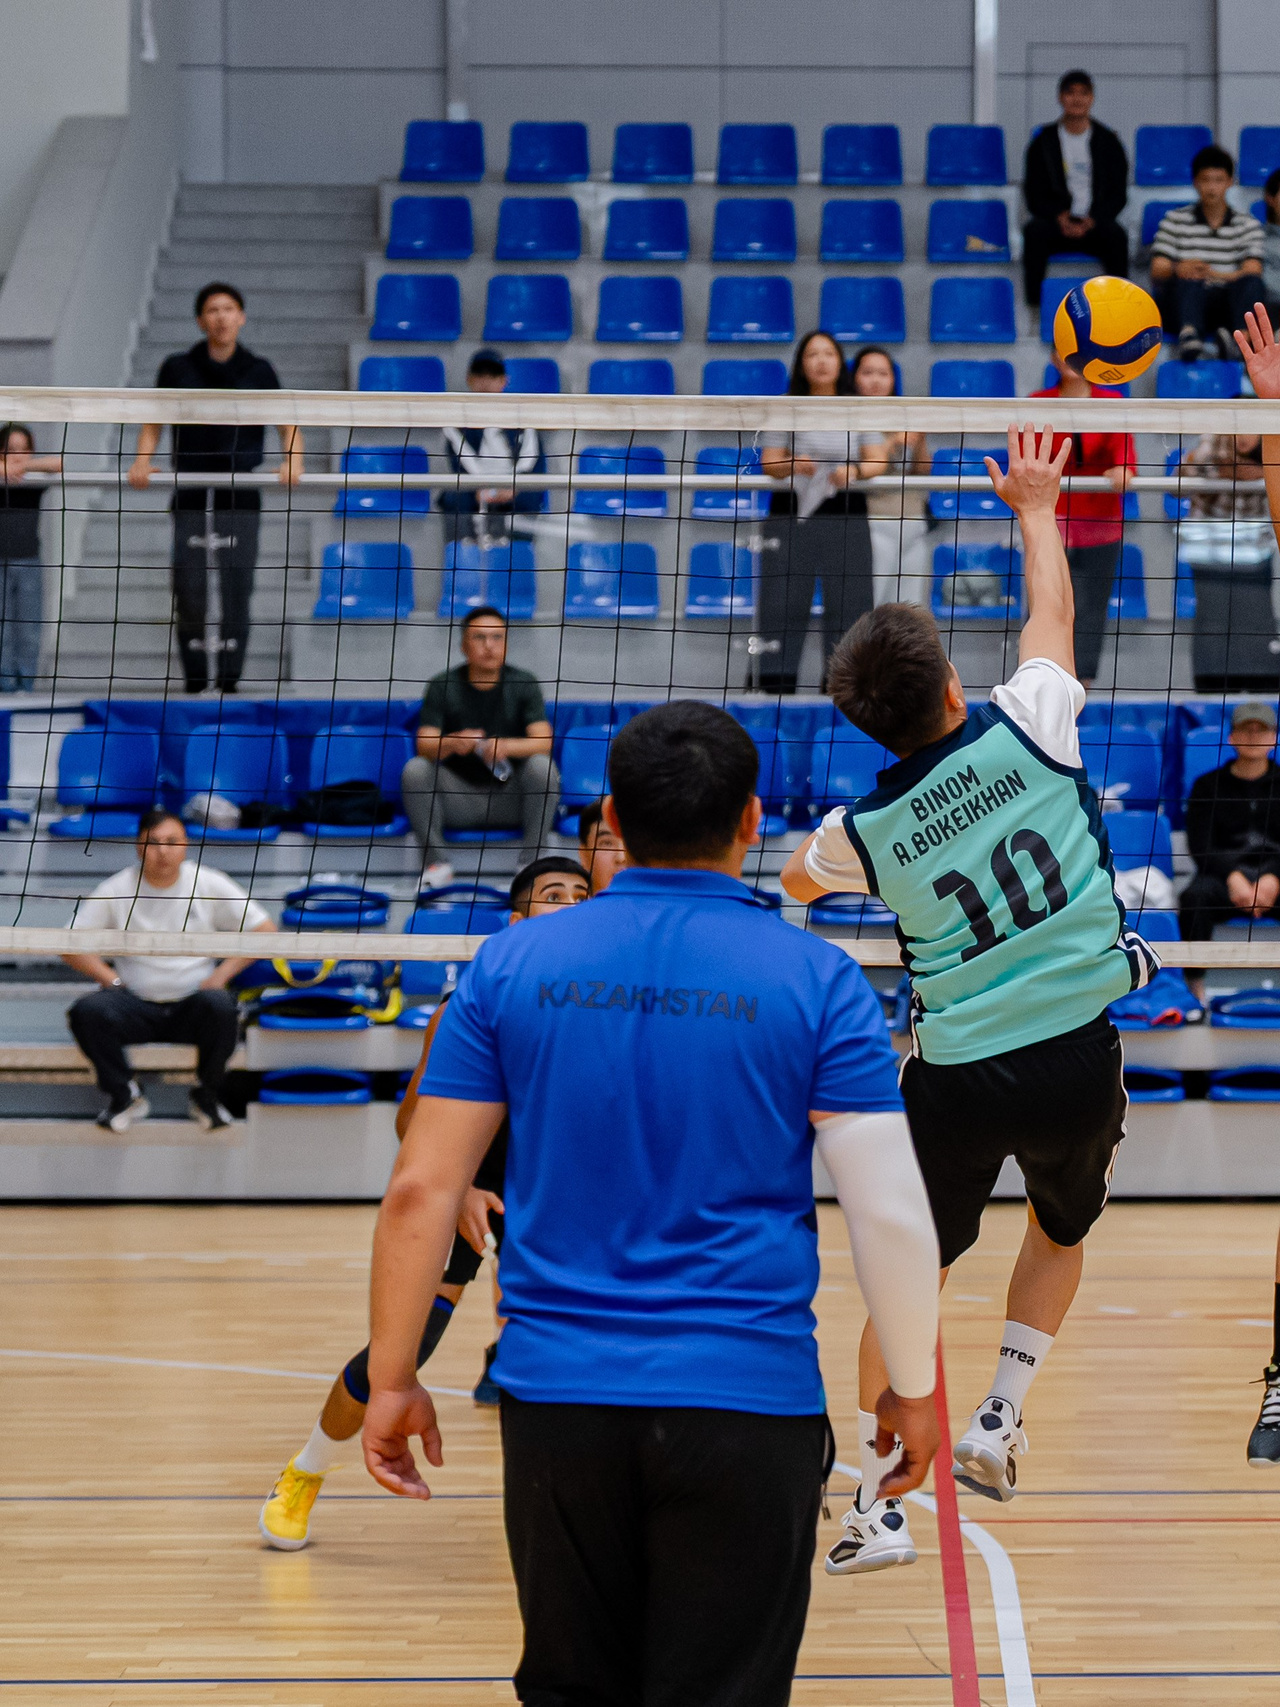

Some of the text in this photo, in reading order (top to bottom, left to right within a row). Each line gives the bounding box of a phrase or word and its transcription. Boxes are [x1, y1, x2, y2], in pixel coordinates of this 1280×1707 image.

[892, 769, 1028, 867] A.BOKEIKHAN
[910, 764, 981, 823] BINOM
[932, 829, 1068, 963] 10
[538, 980, 758, 1023] KAZAKHSTAN
